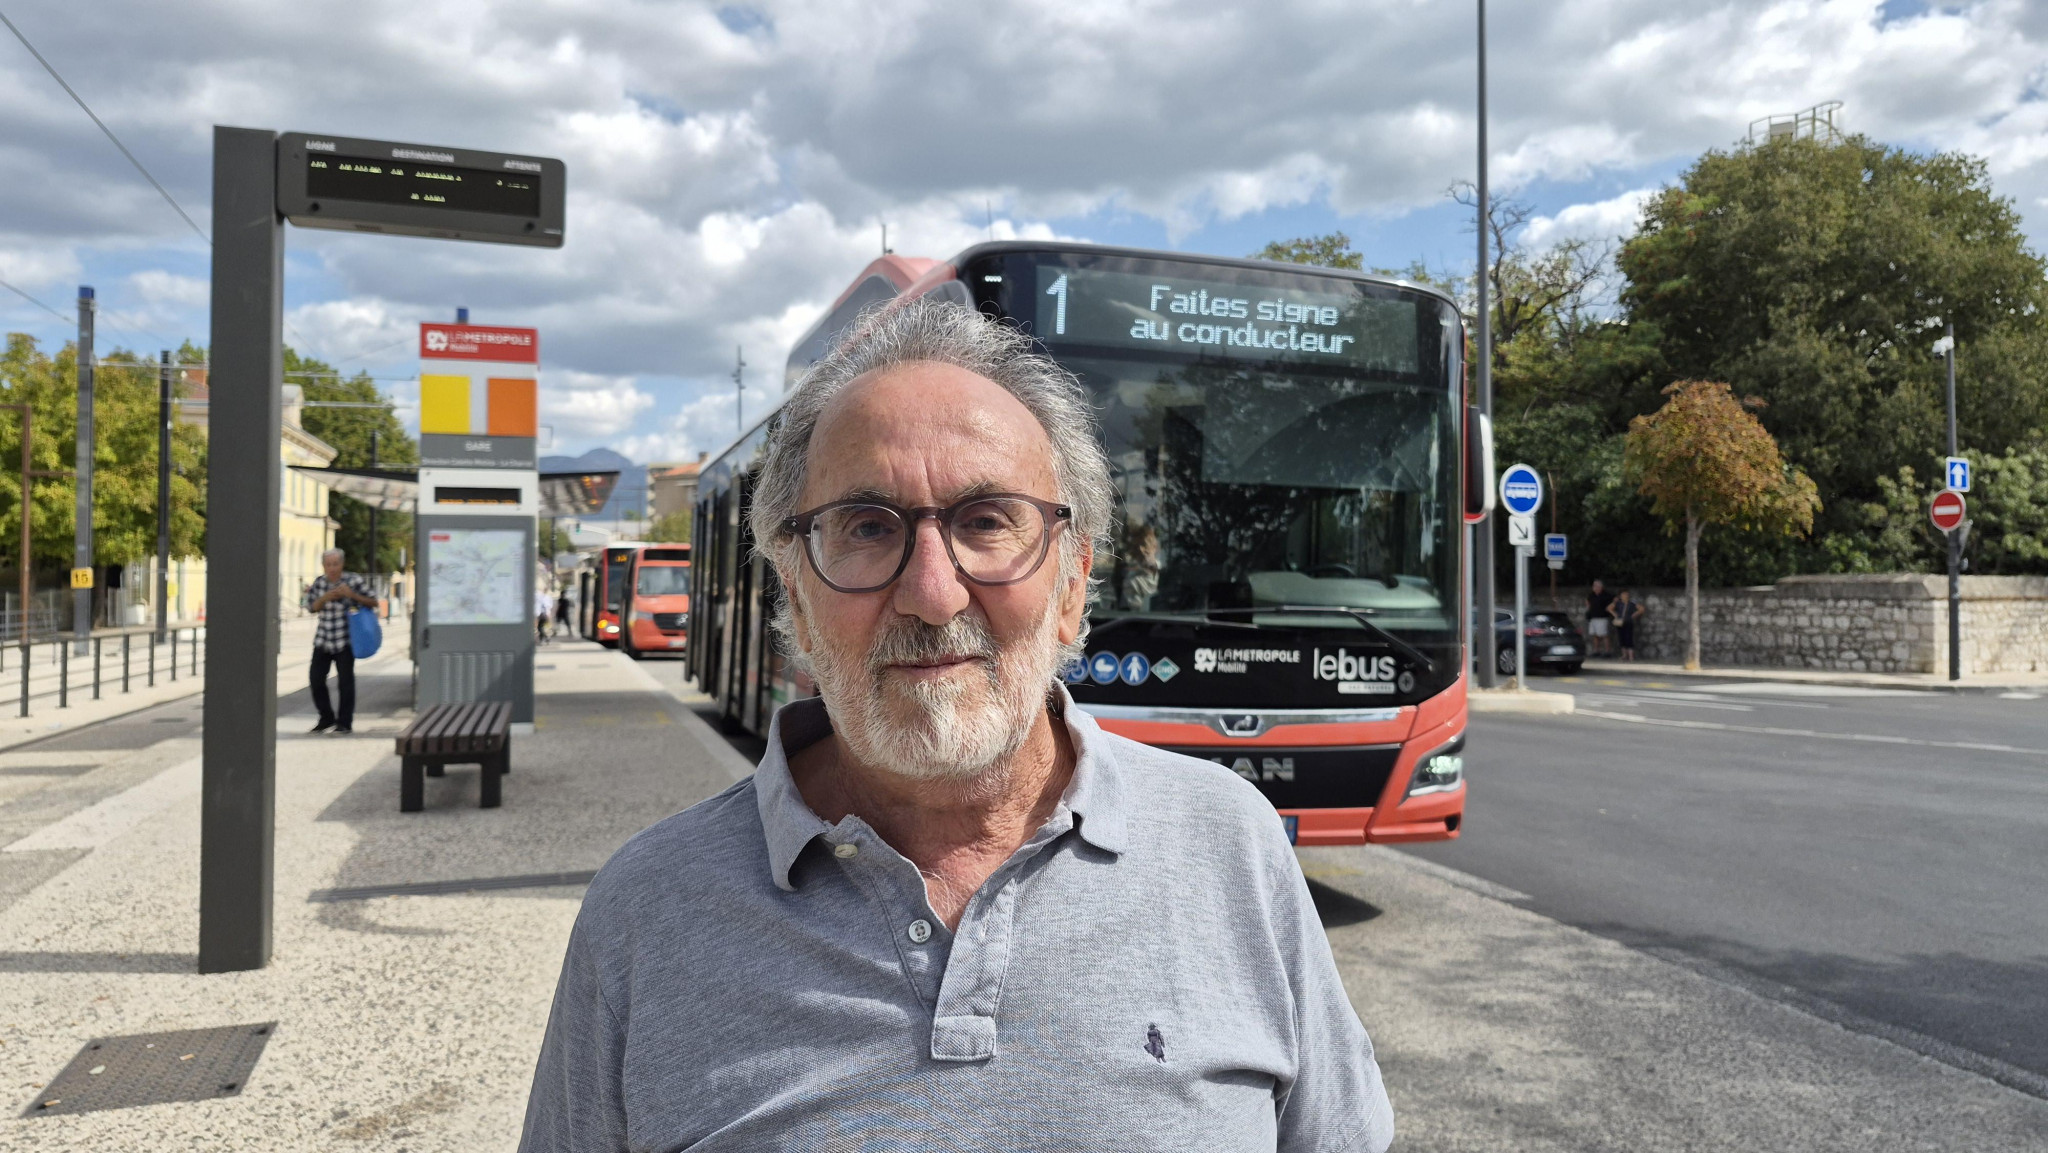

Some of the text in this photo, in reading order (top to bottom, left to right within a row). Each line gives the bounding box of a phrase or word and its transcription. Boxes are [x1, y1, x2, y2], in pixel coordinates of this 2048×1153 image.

[392, 148, 454, 162] DESTINATION
[1046, 273, 1068, 334] 1
[1150, 284, 1339, 326] Faites signe
[1130, 318, 1355, 353] au conducteur
[1313, 647, 1396, 681] lebus
[1210, 757, 1294, 781] AN
